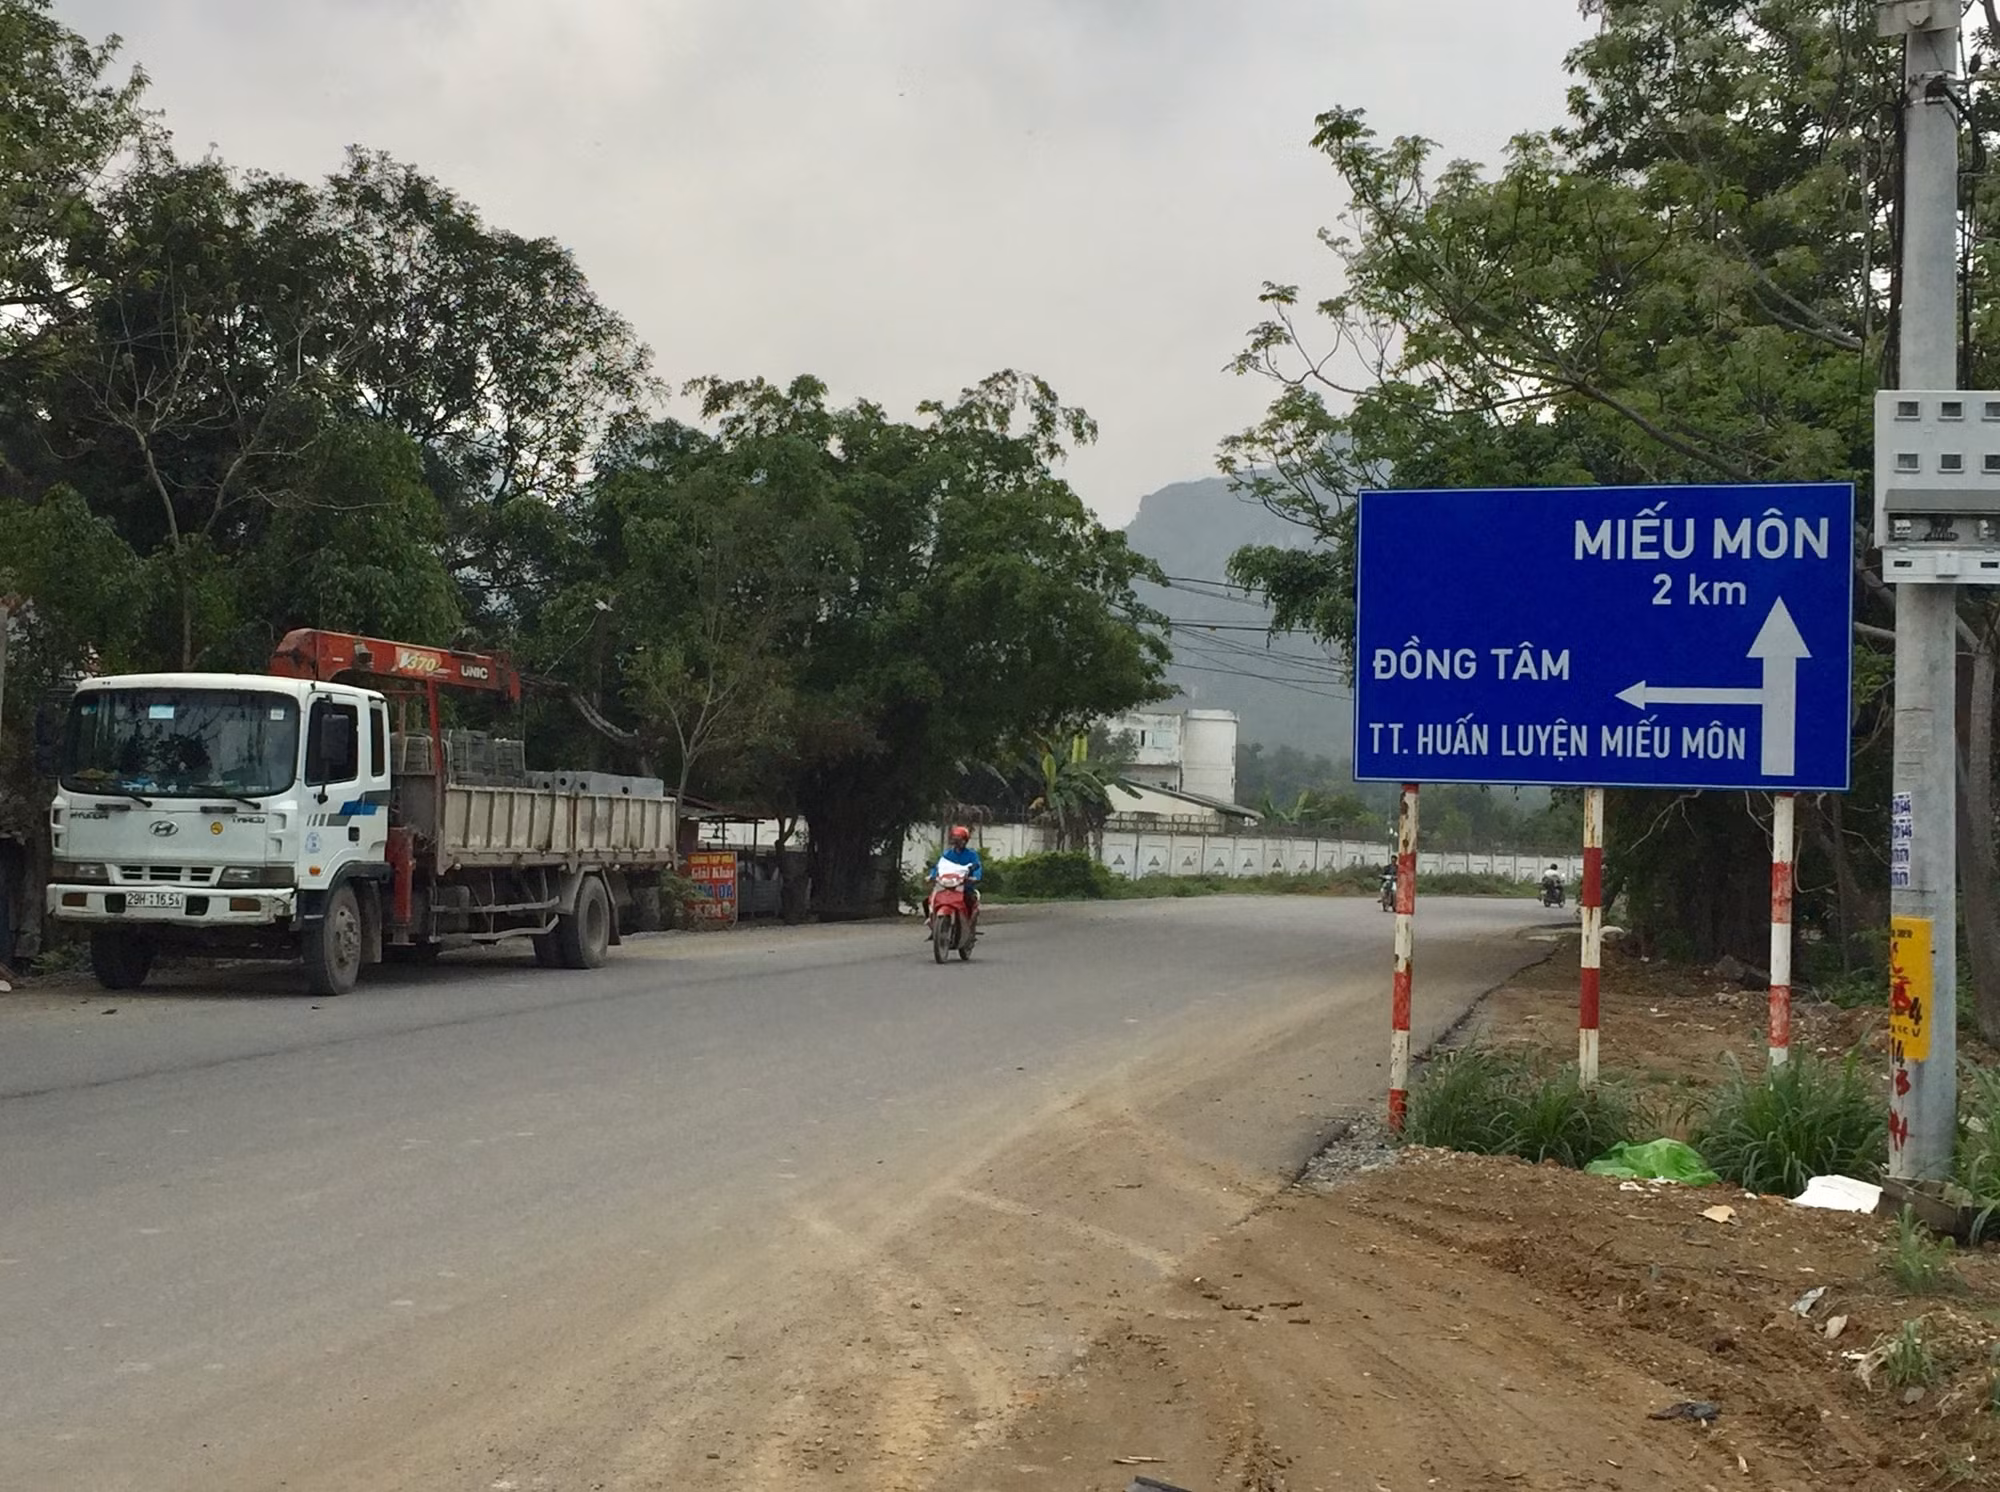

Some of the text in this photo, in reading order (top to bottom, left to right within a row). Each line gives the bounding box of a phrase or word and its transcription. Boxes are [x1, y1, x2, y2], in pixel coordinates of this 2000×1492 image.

[1575, 502, 1828, 560] MIẾU MÔN
[1653, 574, 1746, 604] 2 km
[461, 664, 488, 680] UNIC
[1373, 636, 1569, 680] ĐỒNG TÂM
[1370, 713, 1745, 761] TT. HUẤN LUYỆN MIẾU MÔN
